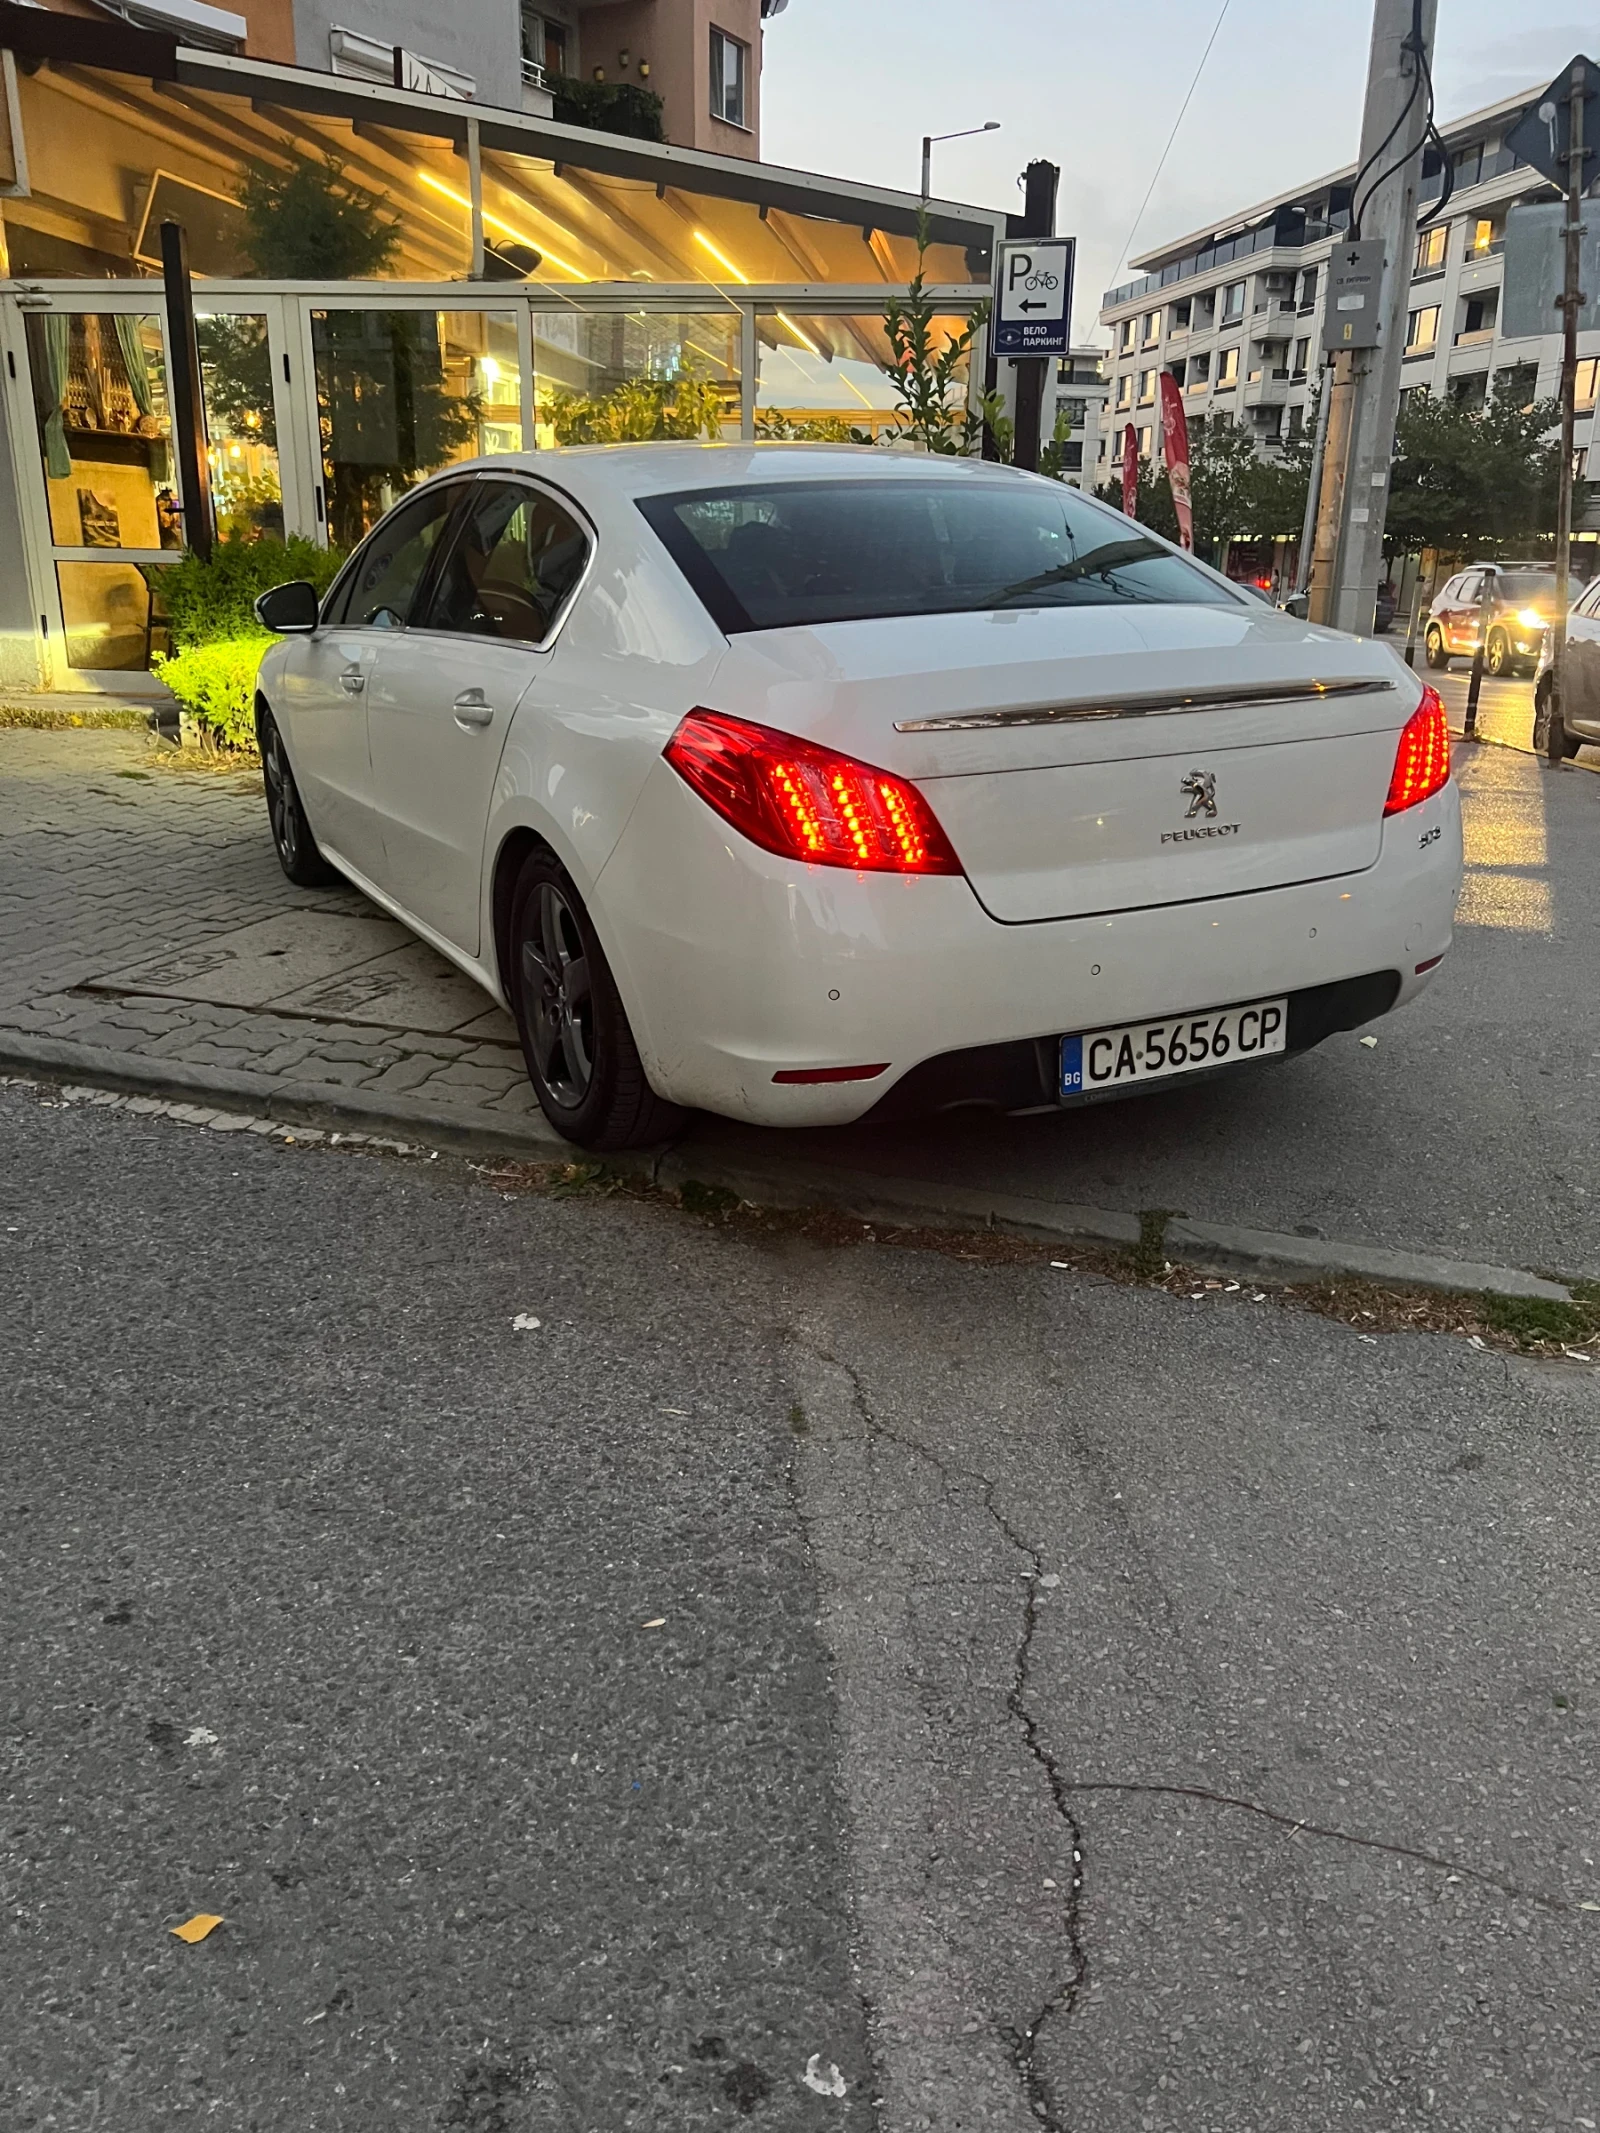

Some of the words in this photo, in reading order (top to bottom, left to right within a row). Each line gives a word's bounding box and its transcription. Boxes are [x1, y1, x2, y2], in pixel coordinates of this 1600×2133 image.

[1009, 253, 1032, 291] P
[1023, 326, 1047, 335] ВЕЛО
[1023, 337, 1063, 346] ПАРКИНГ
[1160, 822, 1242, 844] PEUGEOT
[1418, 825, 1442, 850] 508
[1064, 1072, 1081, 1086] BG
